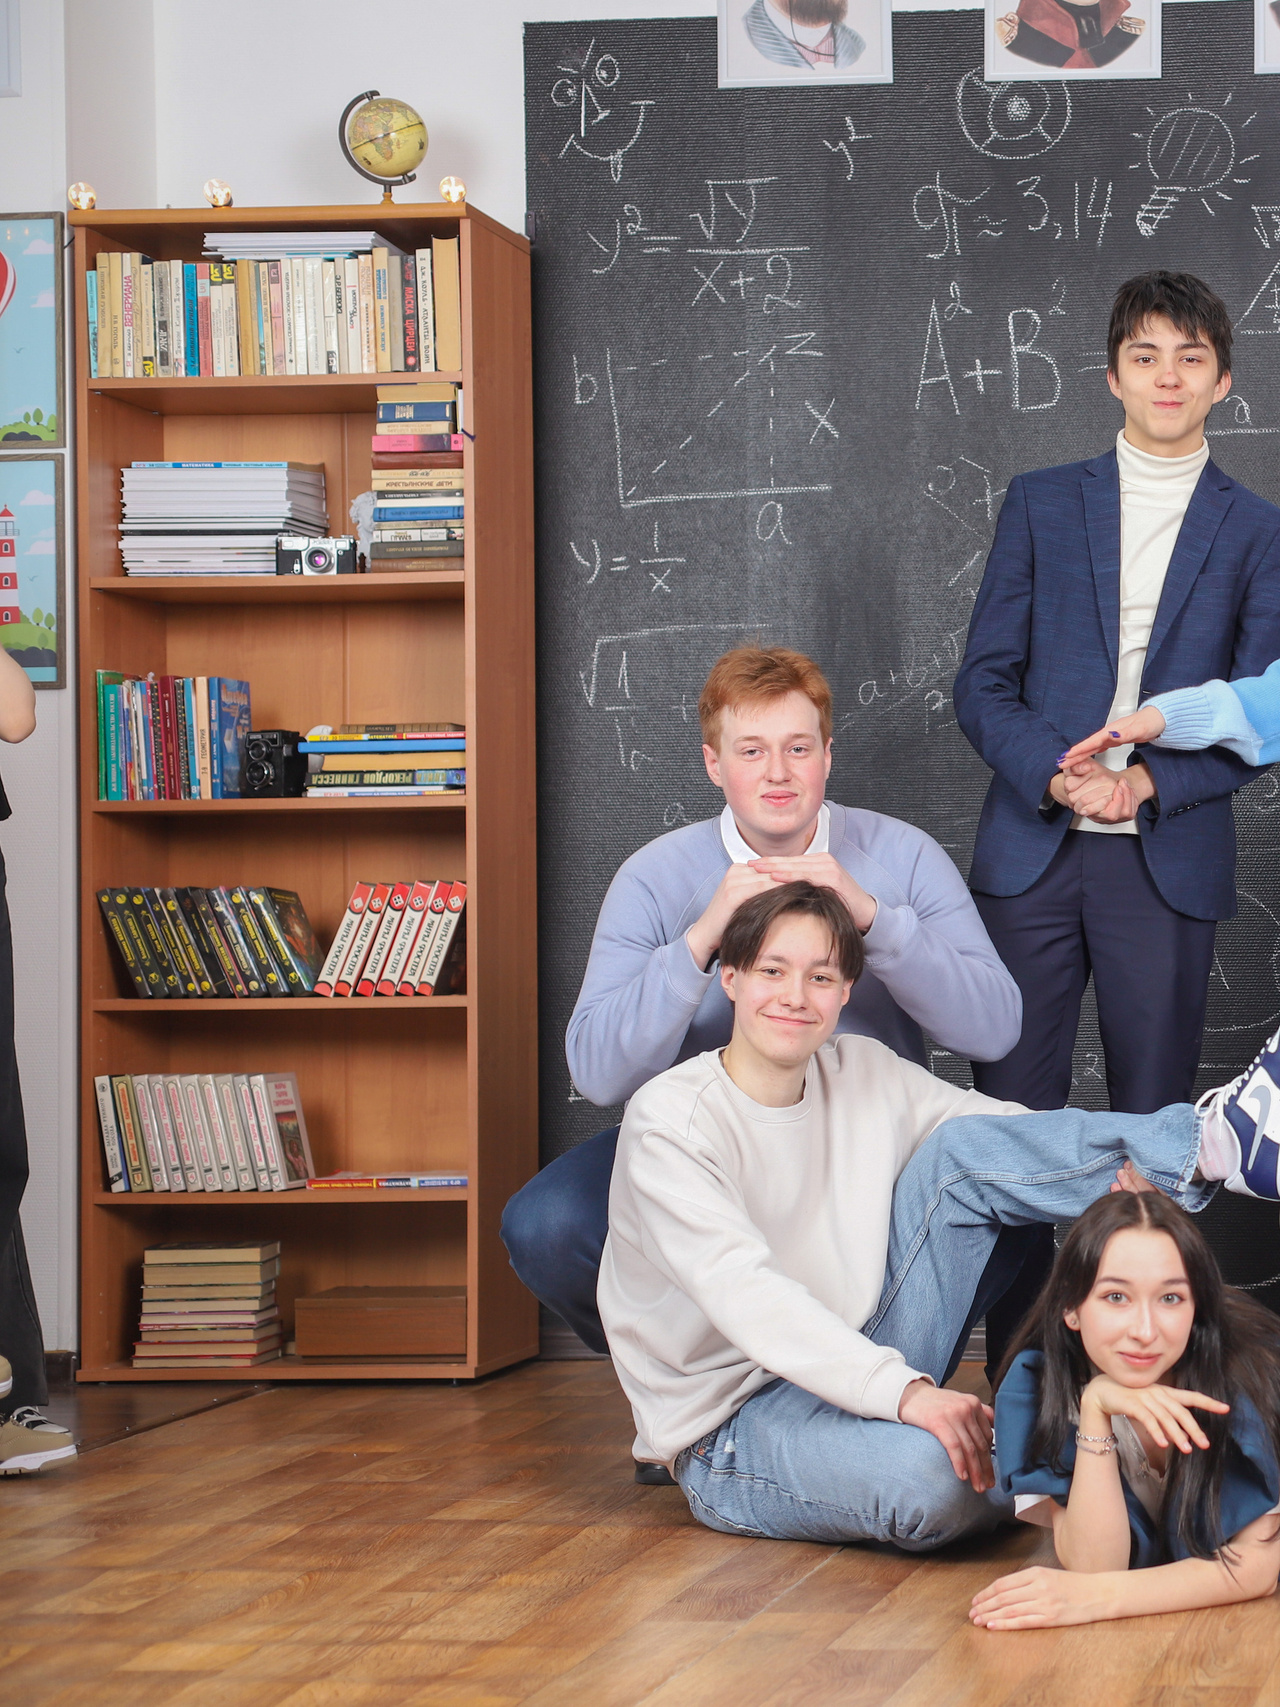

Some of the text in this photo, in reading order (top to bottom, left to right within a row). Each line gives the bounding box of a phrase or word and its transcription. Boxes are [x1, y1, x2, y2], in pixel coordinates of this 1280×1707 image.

[124, 275, 133, 327] ВЕНЕРИАНА
[404, 287, 414, 315] МАСКА
[404, 319, 415, 352] ЦИРЦЕИ
[312, 774, 360, 785] ГИННЕССА
[363, 772, 413, 784] РЕКОРДОВ
[326, 918, 355, 978] МИРЫ ФОСТЕРА
[345, 918, 374, 978] МИРЫ ФОСТЕРА
[367, 915, 396, 975] МИРЫ ФОСТЕРА
[387, 916, 416, 975] МИРЫ ФОСТЕРА
[407, 918, 436, 978] МИРЫ ФОСТЕРА
[424, 917, 454, 977] МИРЫ ФОСТЕРА
